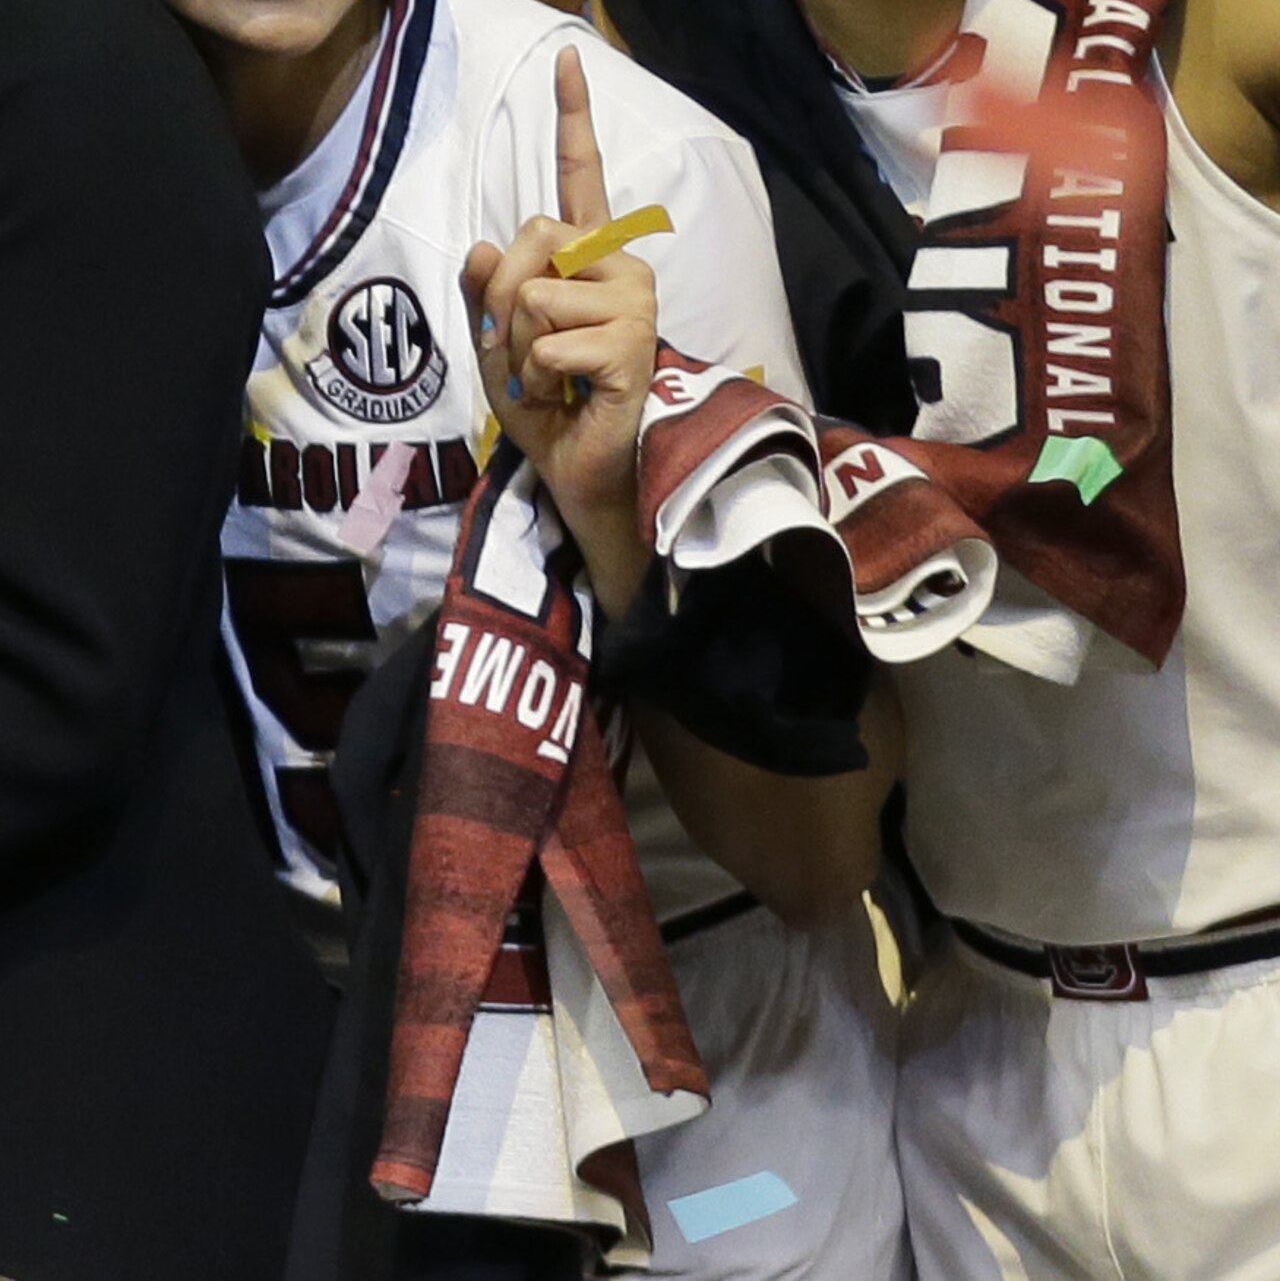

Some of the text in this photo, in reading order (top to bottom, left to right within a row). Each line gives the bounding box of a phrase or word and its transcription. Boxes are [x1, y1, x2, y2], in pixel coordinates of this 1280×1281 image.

[1042, 126, 1127, 433] ATIONAL
[339, 284, 422, 386] SEC
[327, 378, 436, 420] GRADUATE
